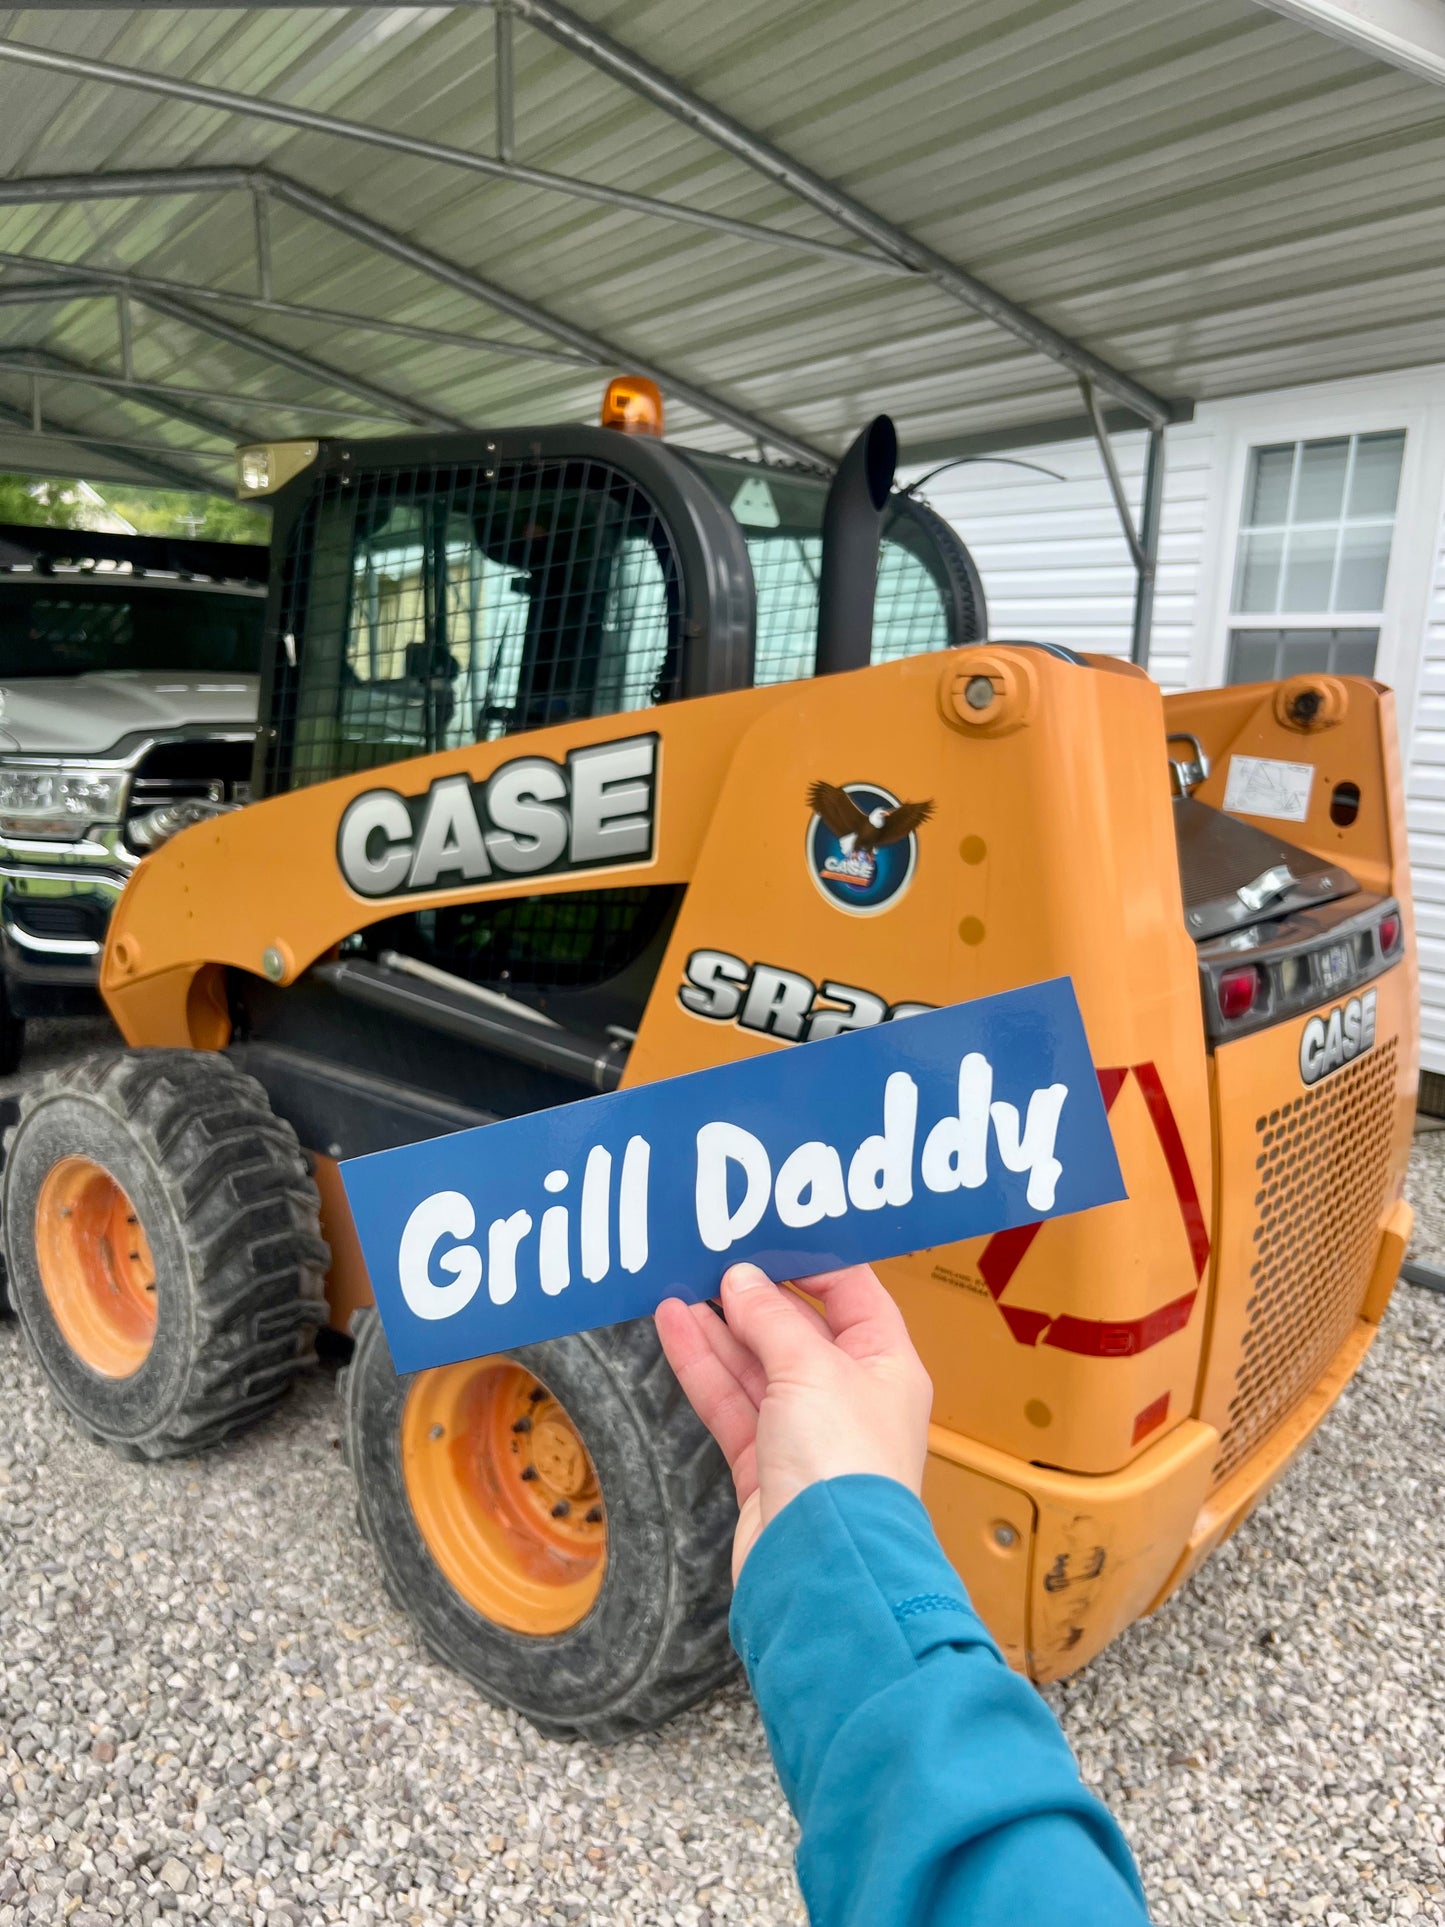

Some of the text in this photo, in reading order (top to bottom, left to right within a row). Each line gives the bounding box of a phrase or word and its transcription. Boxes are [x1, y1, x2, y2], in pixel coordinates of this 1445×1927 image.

[338, 734, 658, 897] CASE
[824, 856, 875, 878] CASE
[679, 948, 945, 1042] SR2
[1301, 988, 1376, 1084] CASE
[399, 1053, 1068, 1320] Grill Daddy
